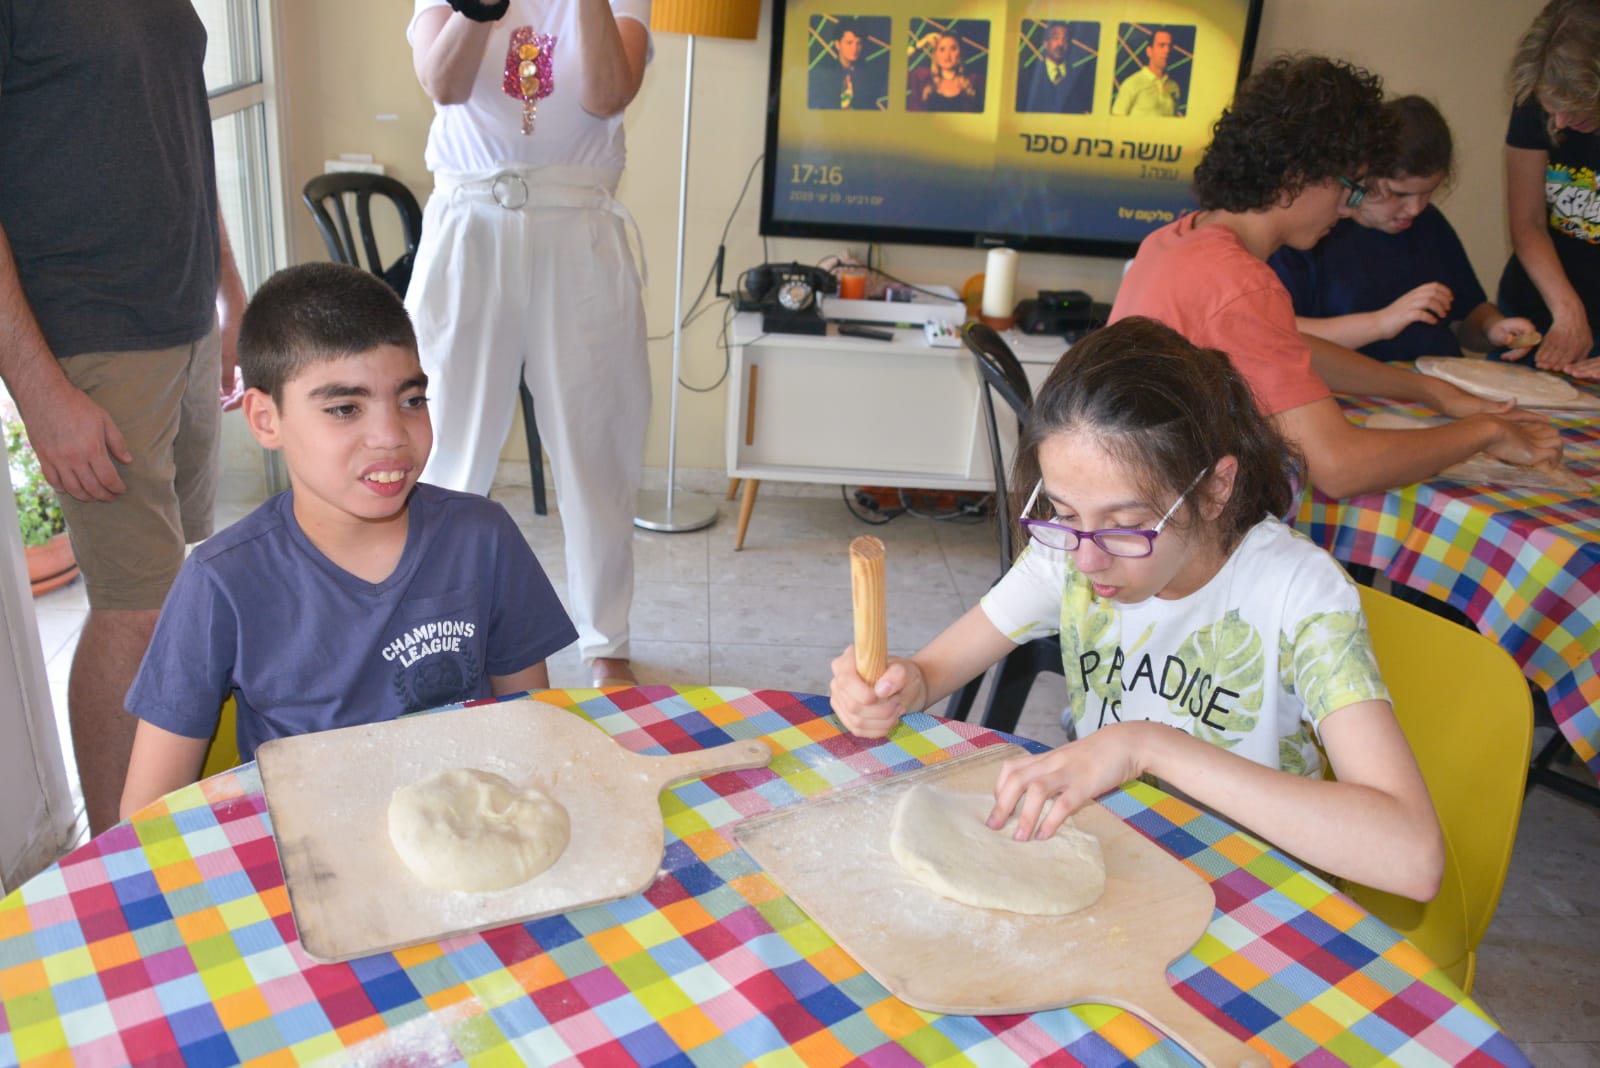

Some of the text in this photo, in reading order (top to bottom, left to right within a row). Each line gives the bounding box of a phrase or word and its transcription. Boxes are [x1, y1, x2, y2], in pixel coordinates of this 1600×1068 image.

[1019, 133, 1182, 163] עושה בית ספר
[791, 164, 843, 186] 17:16
[1118, 207, 1175, 223] סלקום tv
[382, 621, 475, 661] CHAMPIONS
[399, 637, 461, 668] LEAGUE
[1080, 646, 1240, 731] PARADISE
